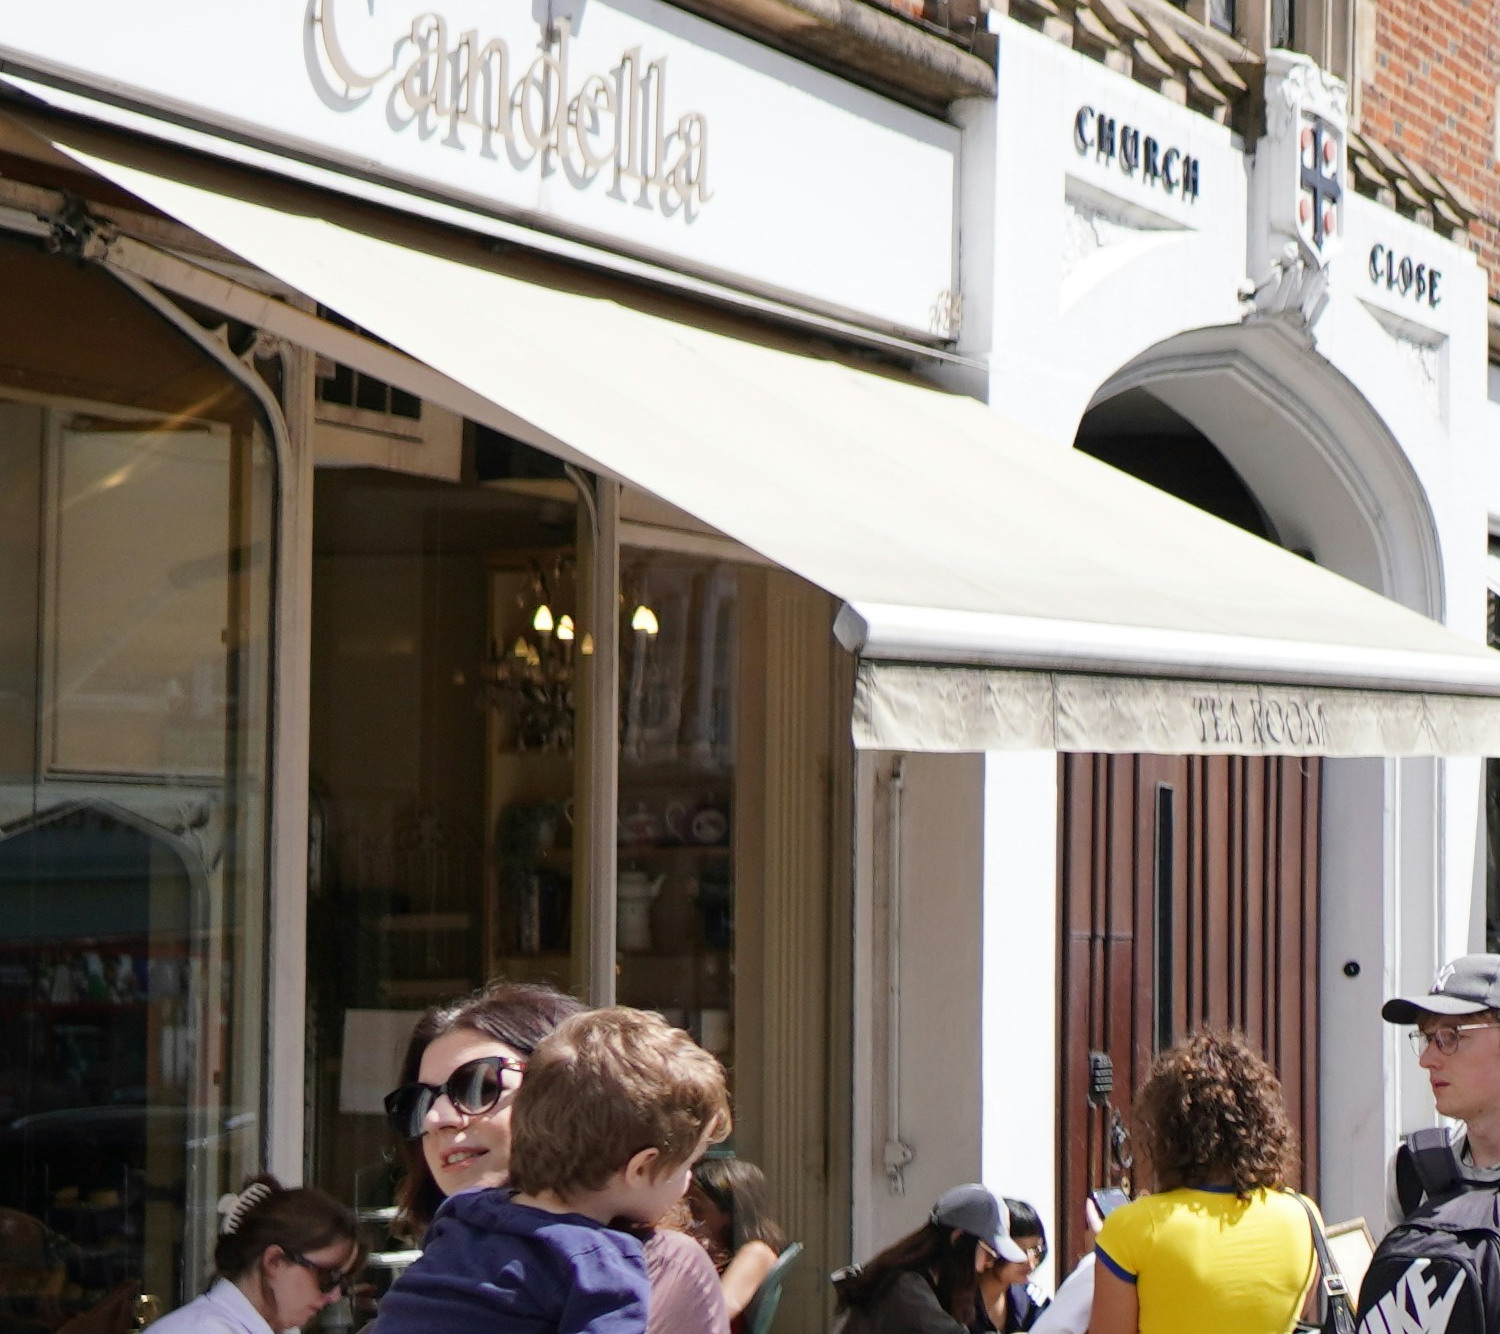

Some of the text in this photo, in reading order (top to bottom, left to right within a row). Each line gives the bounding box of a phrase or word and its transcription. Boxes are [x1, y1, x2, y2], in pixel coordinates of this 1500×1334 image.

[1074, 105, 1198, 202] CHURCH
[1369, 243, 1442, 307] CLOSE
[1193, 696, 1327, 746] TEA ROOM
